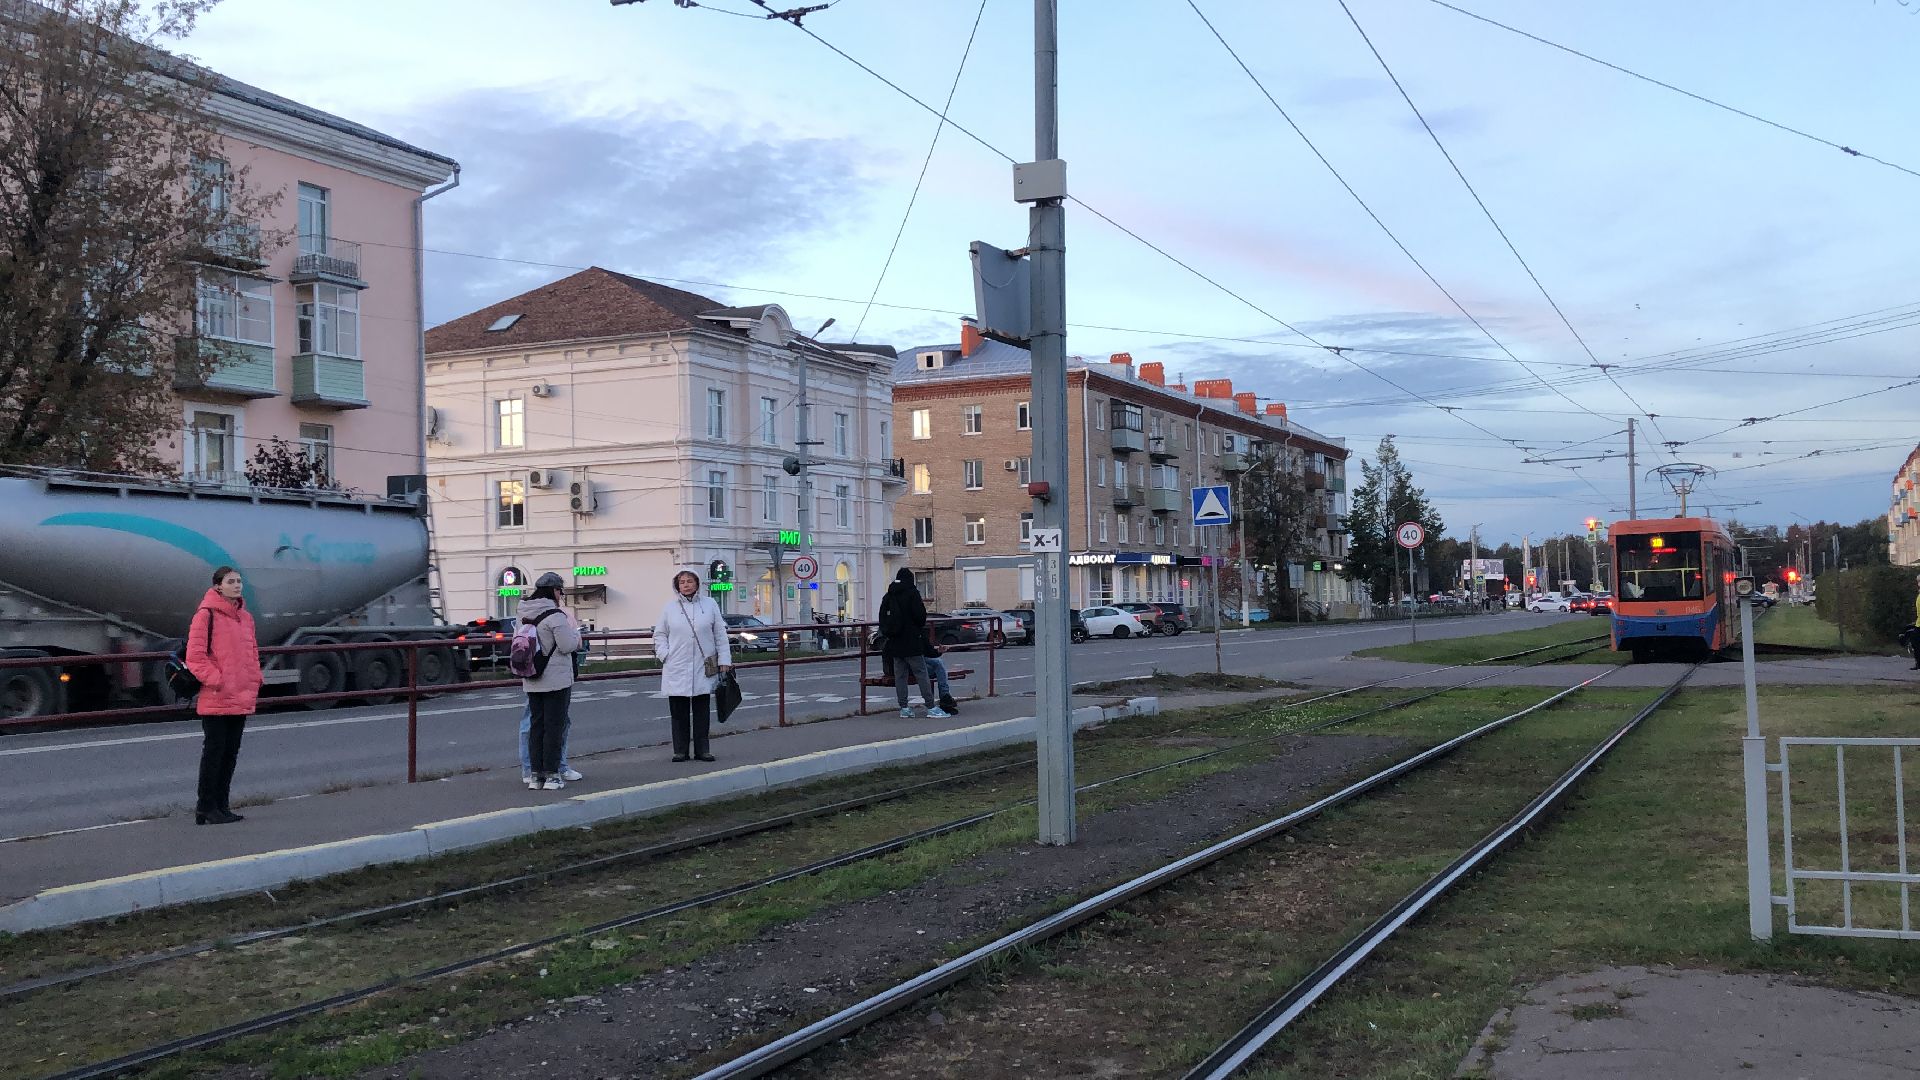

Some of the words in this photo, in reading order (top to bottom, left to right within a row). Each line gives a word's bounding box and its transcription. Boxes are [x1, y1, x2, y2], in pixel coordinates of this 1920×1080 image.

[780, 530, 813, 546] РИГ
[1402, 529, 1418, 540] 40
[1069, 554, 1116, 566] АДВОКАТ
[798, 563, 811, 573] 40
